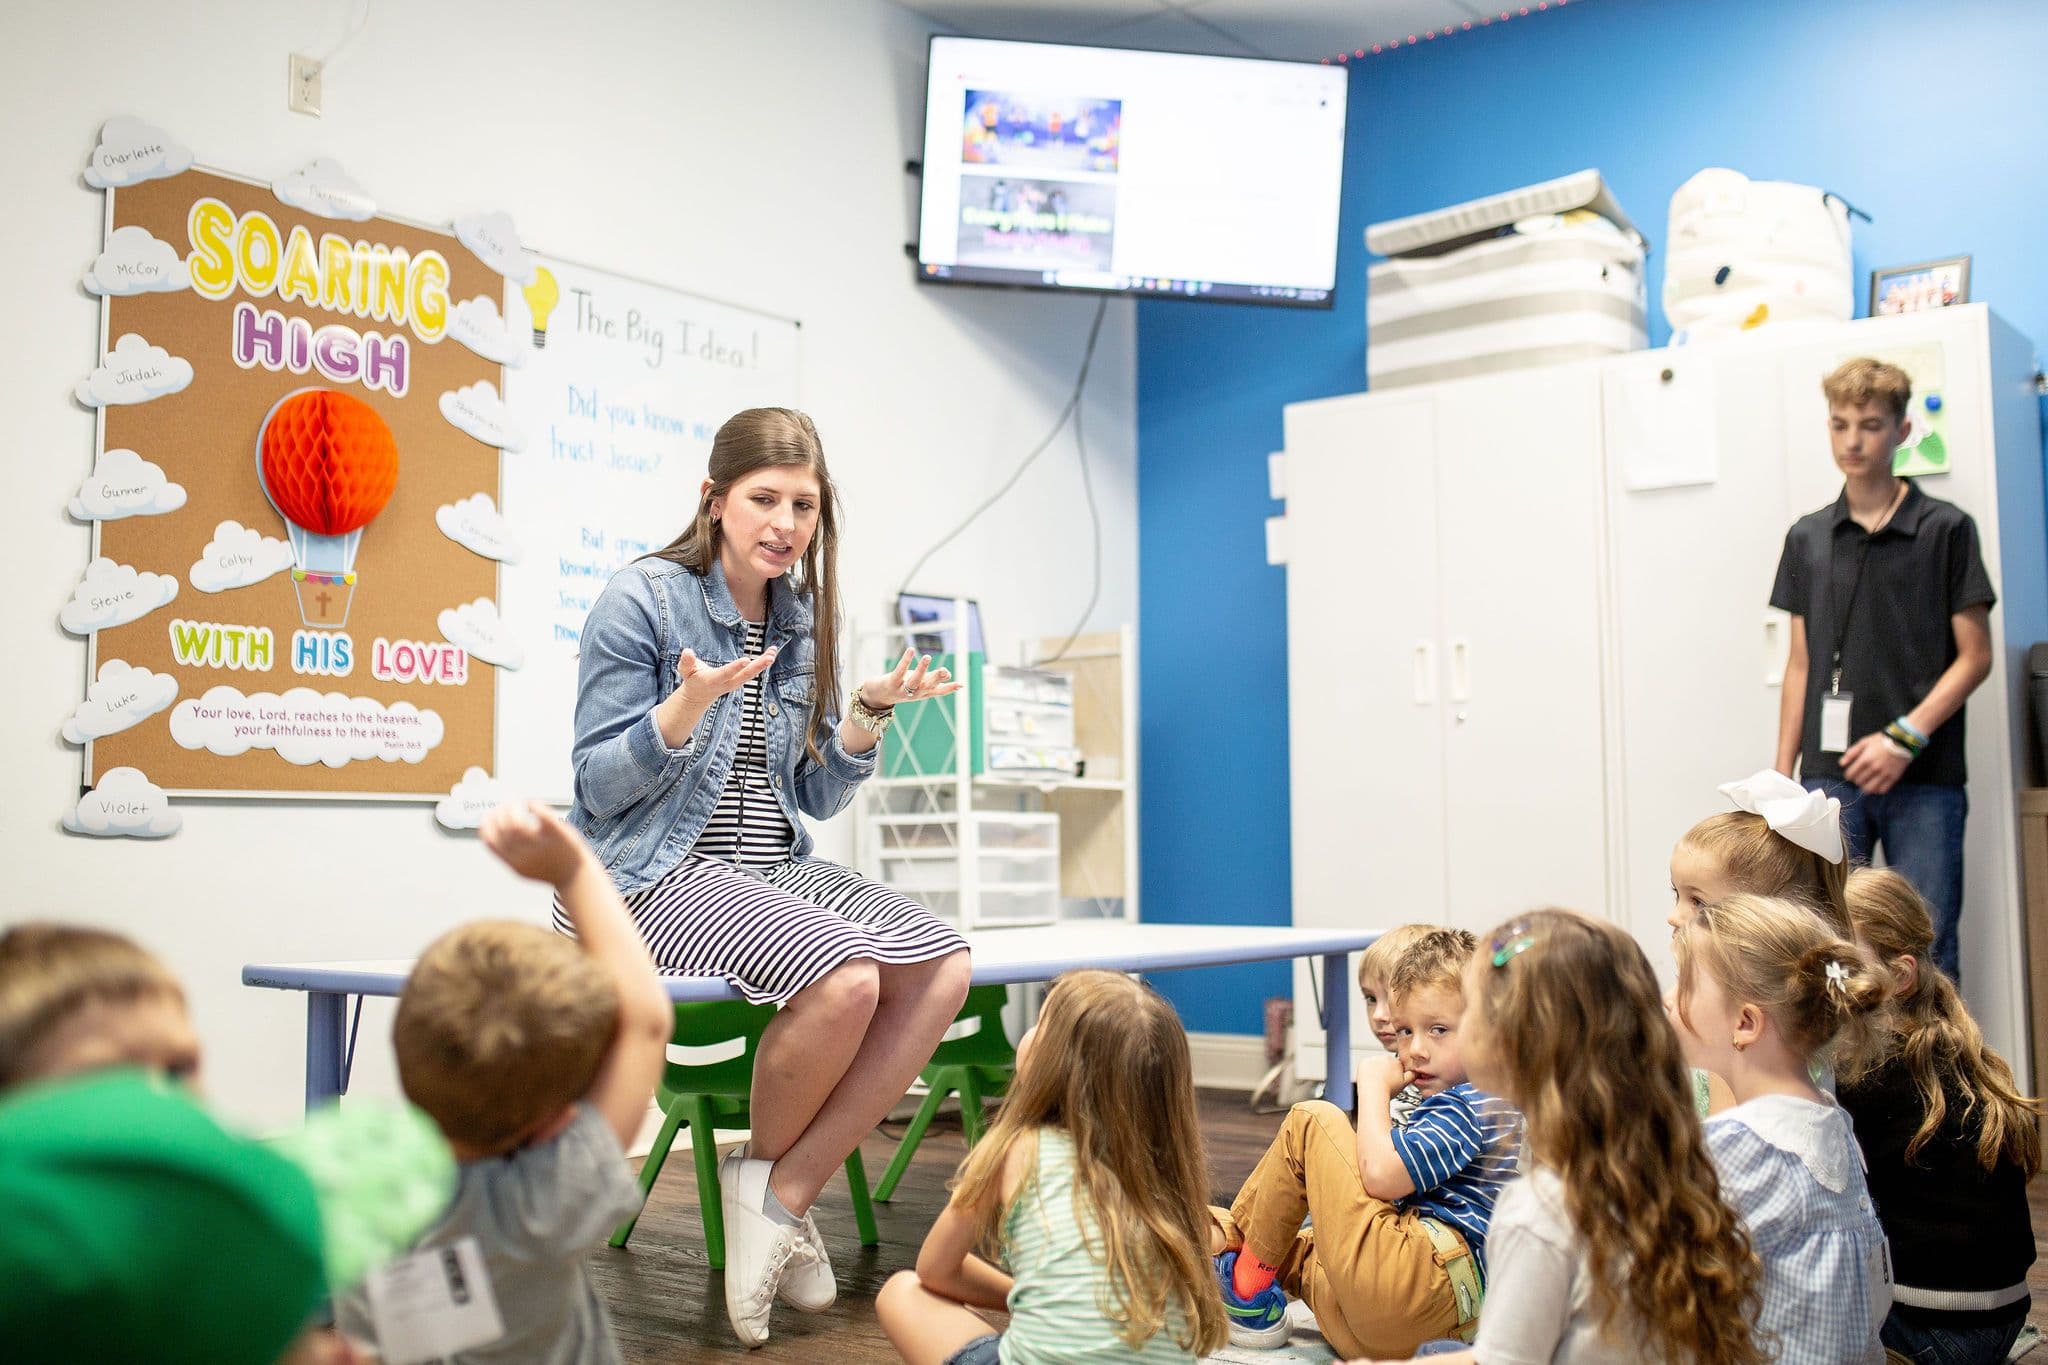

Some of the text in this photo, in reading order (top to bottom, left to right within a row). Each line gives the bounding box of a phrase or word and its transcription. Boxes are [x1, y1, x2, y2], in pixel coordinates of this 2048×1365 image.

[102, 144, 165, 168] Charlotte
[116, 260, 160, 276] McCoy
[189, 199, 448, 342] SOARING
[568, 286, 616, 339] The
[626, 308, 665, 369] Big
[236, 304, 410, 396] HIGH
[115, 366, 163, 386] Judah
[567, 384, 598, 421] Did
[101, 484, 148, 499] Gunner
[218, 550, 254, 569] Colby
[90, 589, 135, 610] Stevie
[173, 623, 467, 682] WITH HIS LOVE!
[106, 691, 139, 713] Luke
[192, 706, 223, 719] Your
[226, 707, 255, 721] love,
[294, 711, 338, 723] reaches
[342, 712, 353, 723] to
[356, 712, 373, 724] the
[234, 725, 263, 738] your
[265, 725, 332, 738] faithfulness
[336, 727, 346, 738] to
[350, 727, 367, 738] the
[99, 799, 150, 816] Violet
